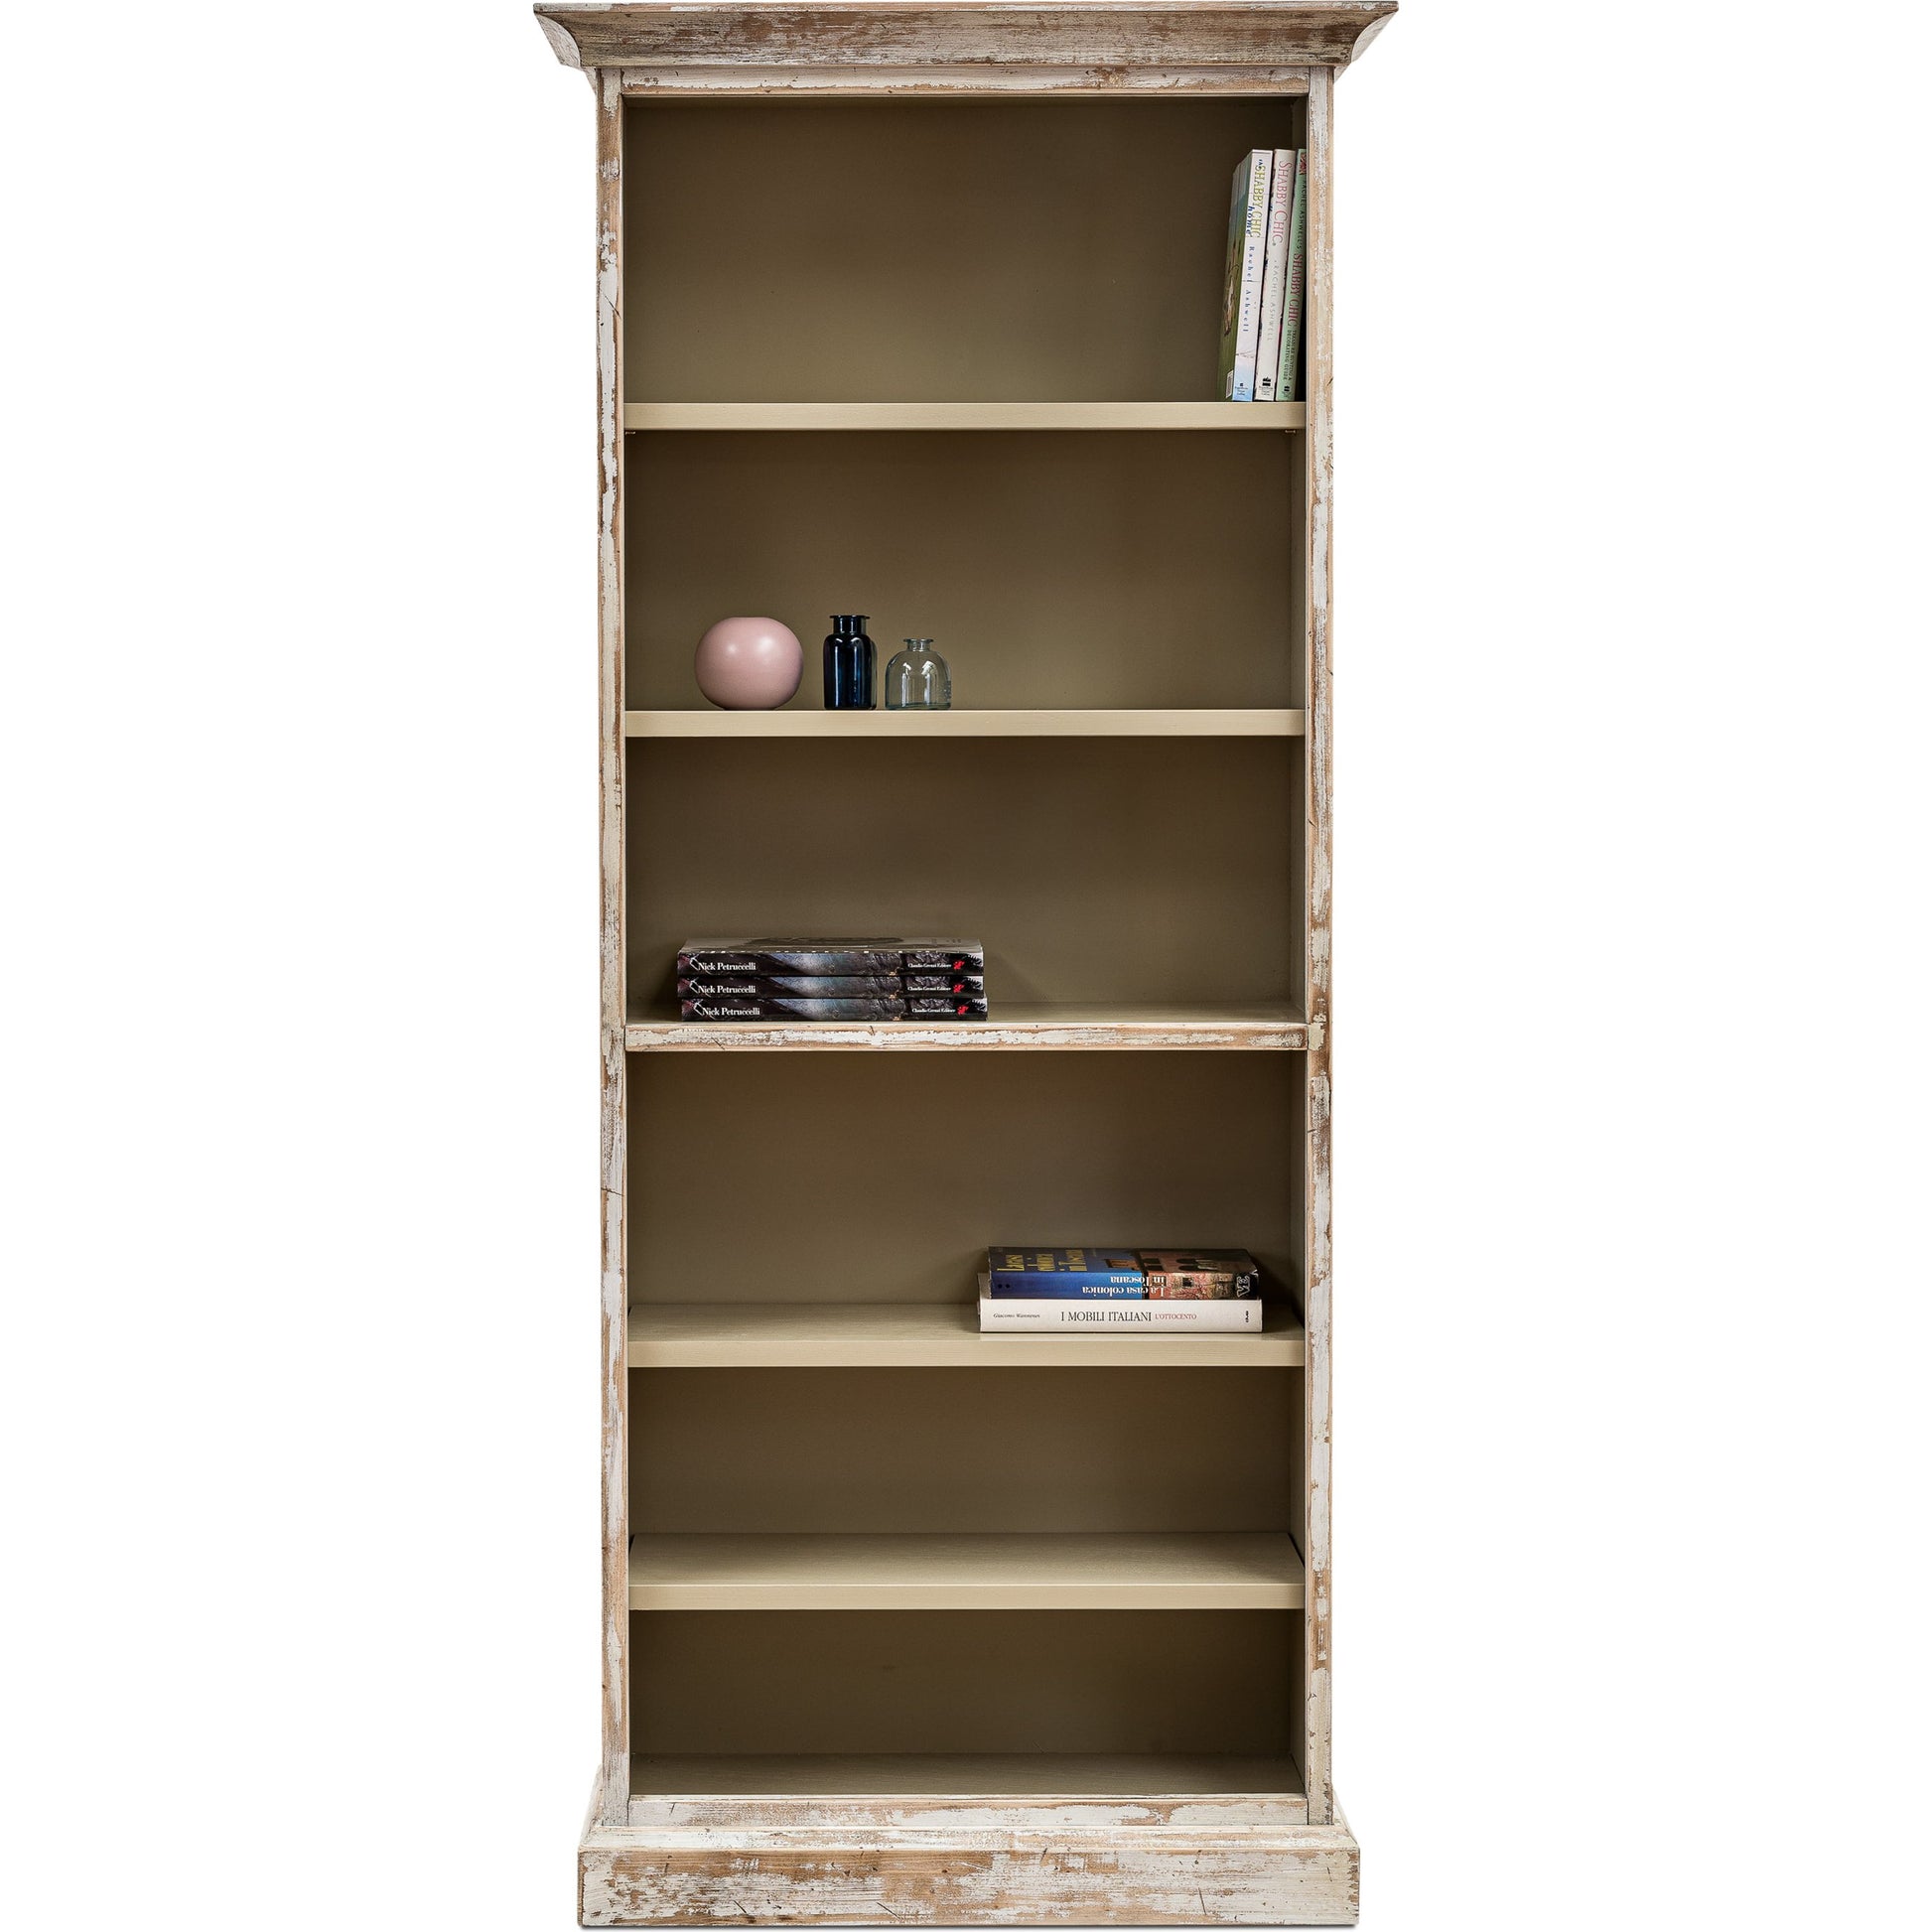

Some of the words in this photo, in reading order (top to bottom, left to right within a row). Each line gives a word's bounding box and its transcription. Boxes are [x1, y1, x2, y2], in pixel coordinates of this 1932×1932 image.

[1252, 165, 1266, 208] SHABBY
[1275, 160, 1293, 207] SHABBY
[1246, 205, 1256, 235] home
[1250, 210, 1263, 237] CHIC
[1246, 246, 1255, 282] Rachel
[1290, 253, 1304, 296] SHABBY
[1270, 265, 1279, 298] RACHEL
[1242, 290, 1252, 332] Ashwell
[1266, 302, 1275, 342] ASHWELL
[1287, 299, 1301, 328] CHIC
[1082, 1287, 1125, 1297] colonica
[1110, 1276, 1152, 1287] Toscana
[1151, 1287, 1165, 1297] La
[1154, 1277, 1165, 1287] in
[1067, 1311, 1104, 1321] MOBILI
[1108, 1311, 1152, 1322] ITALIANI
